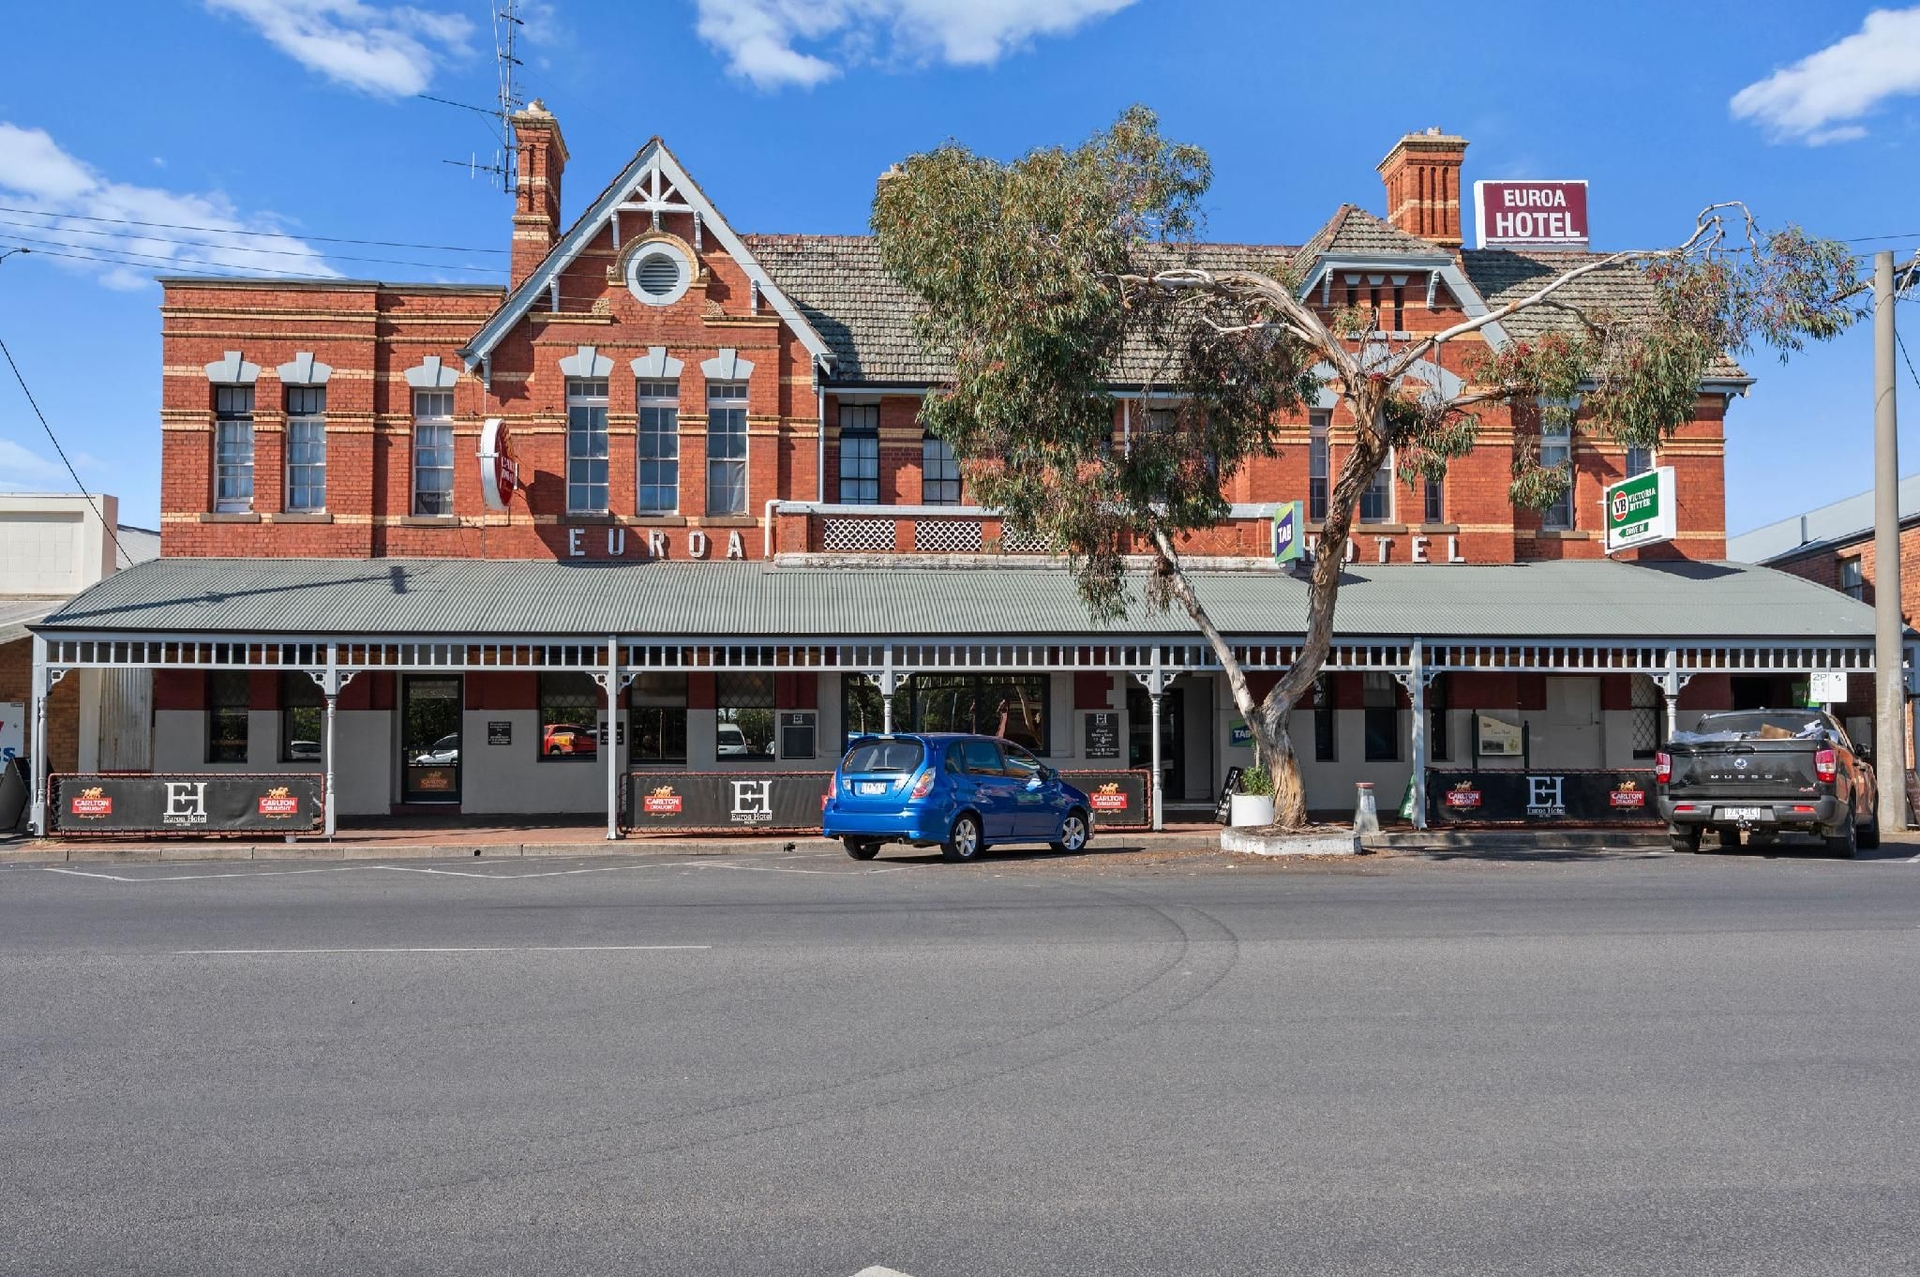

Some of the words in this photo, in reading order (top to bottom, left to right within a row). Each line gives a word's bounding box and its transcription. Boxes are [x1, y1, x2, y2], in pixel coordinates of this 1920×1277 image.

[1503, 189, 1566, 207] EUROA
[1495, 211, 1581, 237] HOTEL
[1629, 488, 1656, 502] VICTORIA
[1615, 499, 1626, 513] VB
[1630, 499, 1650, 511] BITTER
[1277, 523, 1292, 544] TAB
[569, 528, 743, 558] EUROA
[1234, 729, 1251, 738] TAB
[1448, 792, 1479, 800] CARLTON
[163, 815, 186, 823] Euroa
[187, 815, 207, 823] Hotel
[731, 813, 752, 821] Euroa
[754, 813, 773, 821] Hotel
